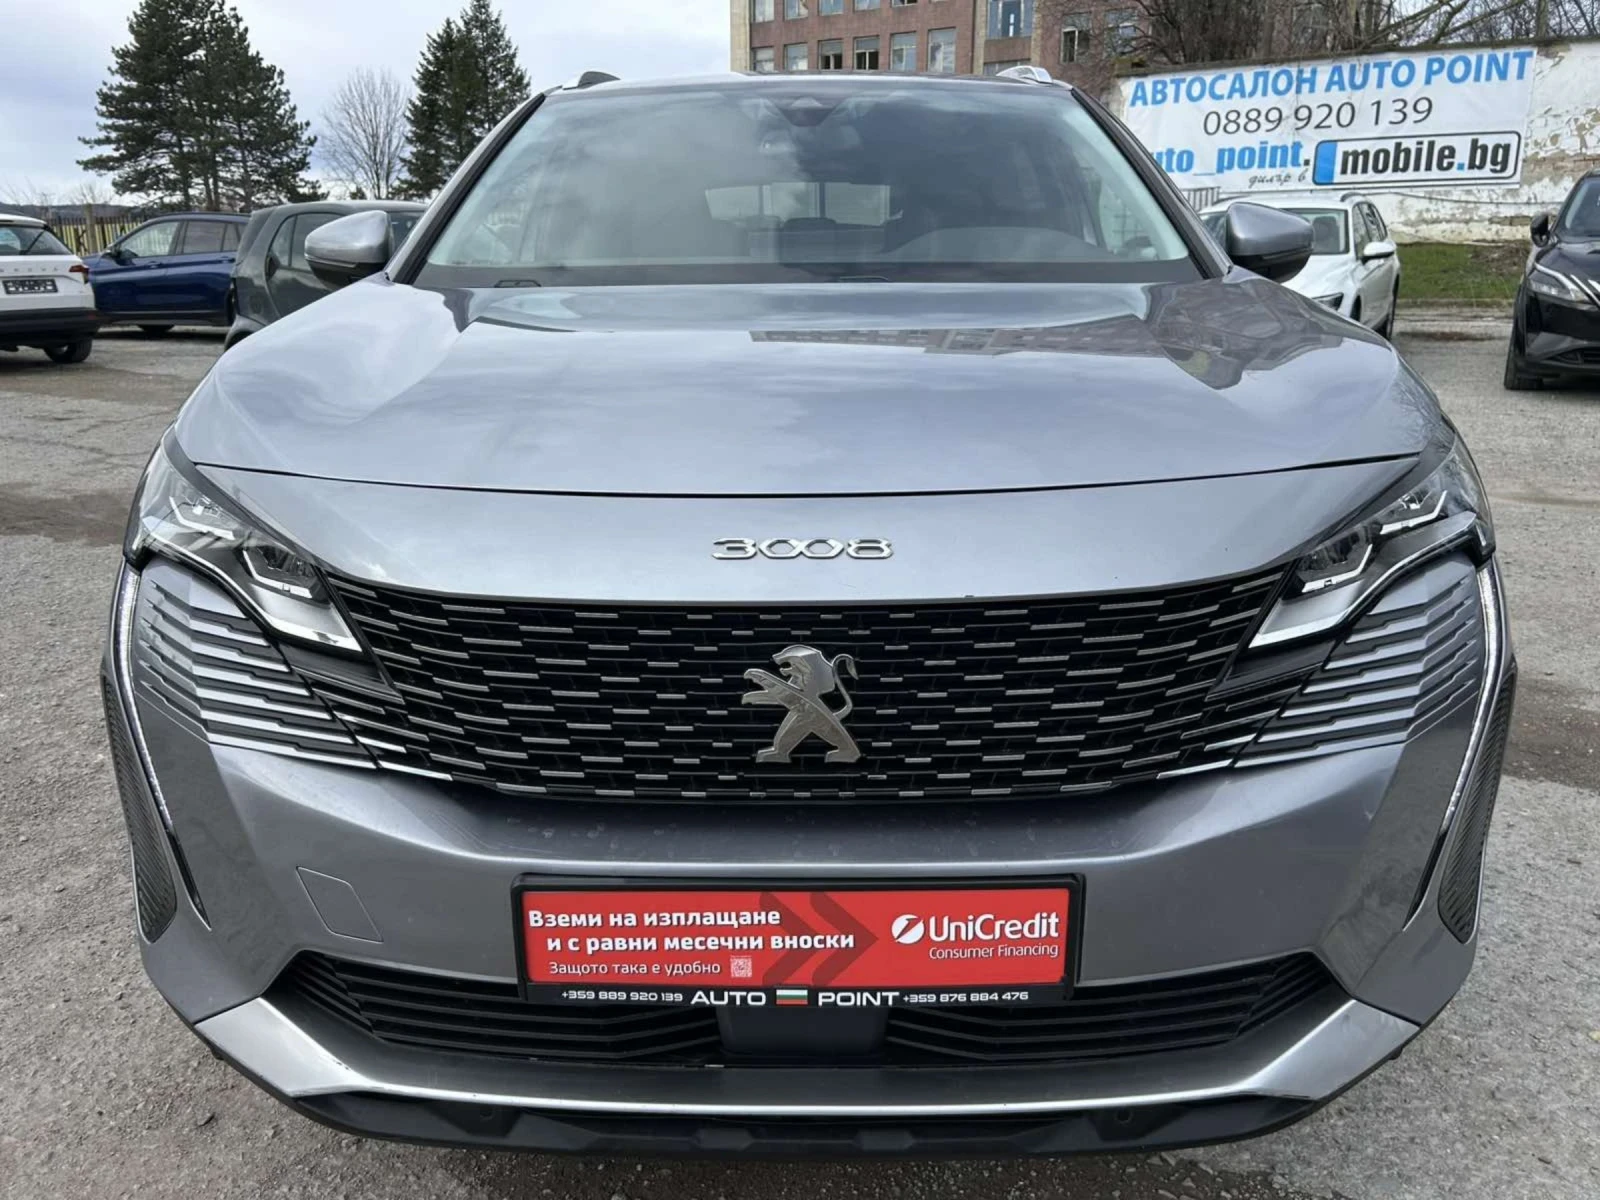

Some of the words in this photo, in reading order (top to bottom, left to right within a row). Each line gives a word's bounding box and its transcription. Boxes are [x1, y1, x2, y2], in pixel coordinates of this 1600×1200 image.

[1129, 66, 1318, 108] АВТОСАЛОН
[1324, 59, 1416, 93] AUTO
[1424, 50, 1534, 86] POINT
[1203, 106, 1283, 137] 0889
[1293, 101, 1356, 131] 920
[1370, 96, 1434, 127] 139
[1339, 138, 1511, 176] mobile.bg
[711, 537, 894, 560] 3008
[528, 910, 602, 928] Вземи
[609, 911, 637, 927] на
[643, 910, 781, 929] изплащане
[928, 911, 1060, 942] UniCredit
[547, 937, 561, 951] и
[567, 937, 580, 951] с
[586, 936, 657, 955] равни
[664, 935, 763, 951] месечни
[770, 934, 855, 949] вноски
[929, 946, 995, 960] Consumer
[997, 943, 1059, 959] Financing
[549, 961, 608, 976] Защото
[612, 962, 647, 974] така
[652, 962, 661, 974] е
[664, 959, 721, 975] удобно
[561, 990, 595, 1000] +359
[598, 991, 627, 1000] 889
[630, 991, 658, 1001] 920
[661, 992, 683, 1001] 139
[690, 990, 767, 1006] AUTO
[817, 991, 900, 1007] POINT
[903, 994, 936, 1003] +359
[939, 993, 967, 1002] 876
[970, 992, 998, 1001] 884
[1001, 991, 1029, 1001] 476
